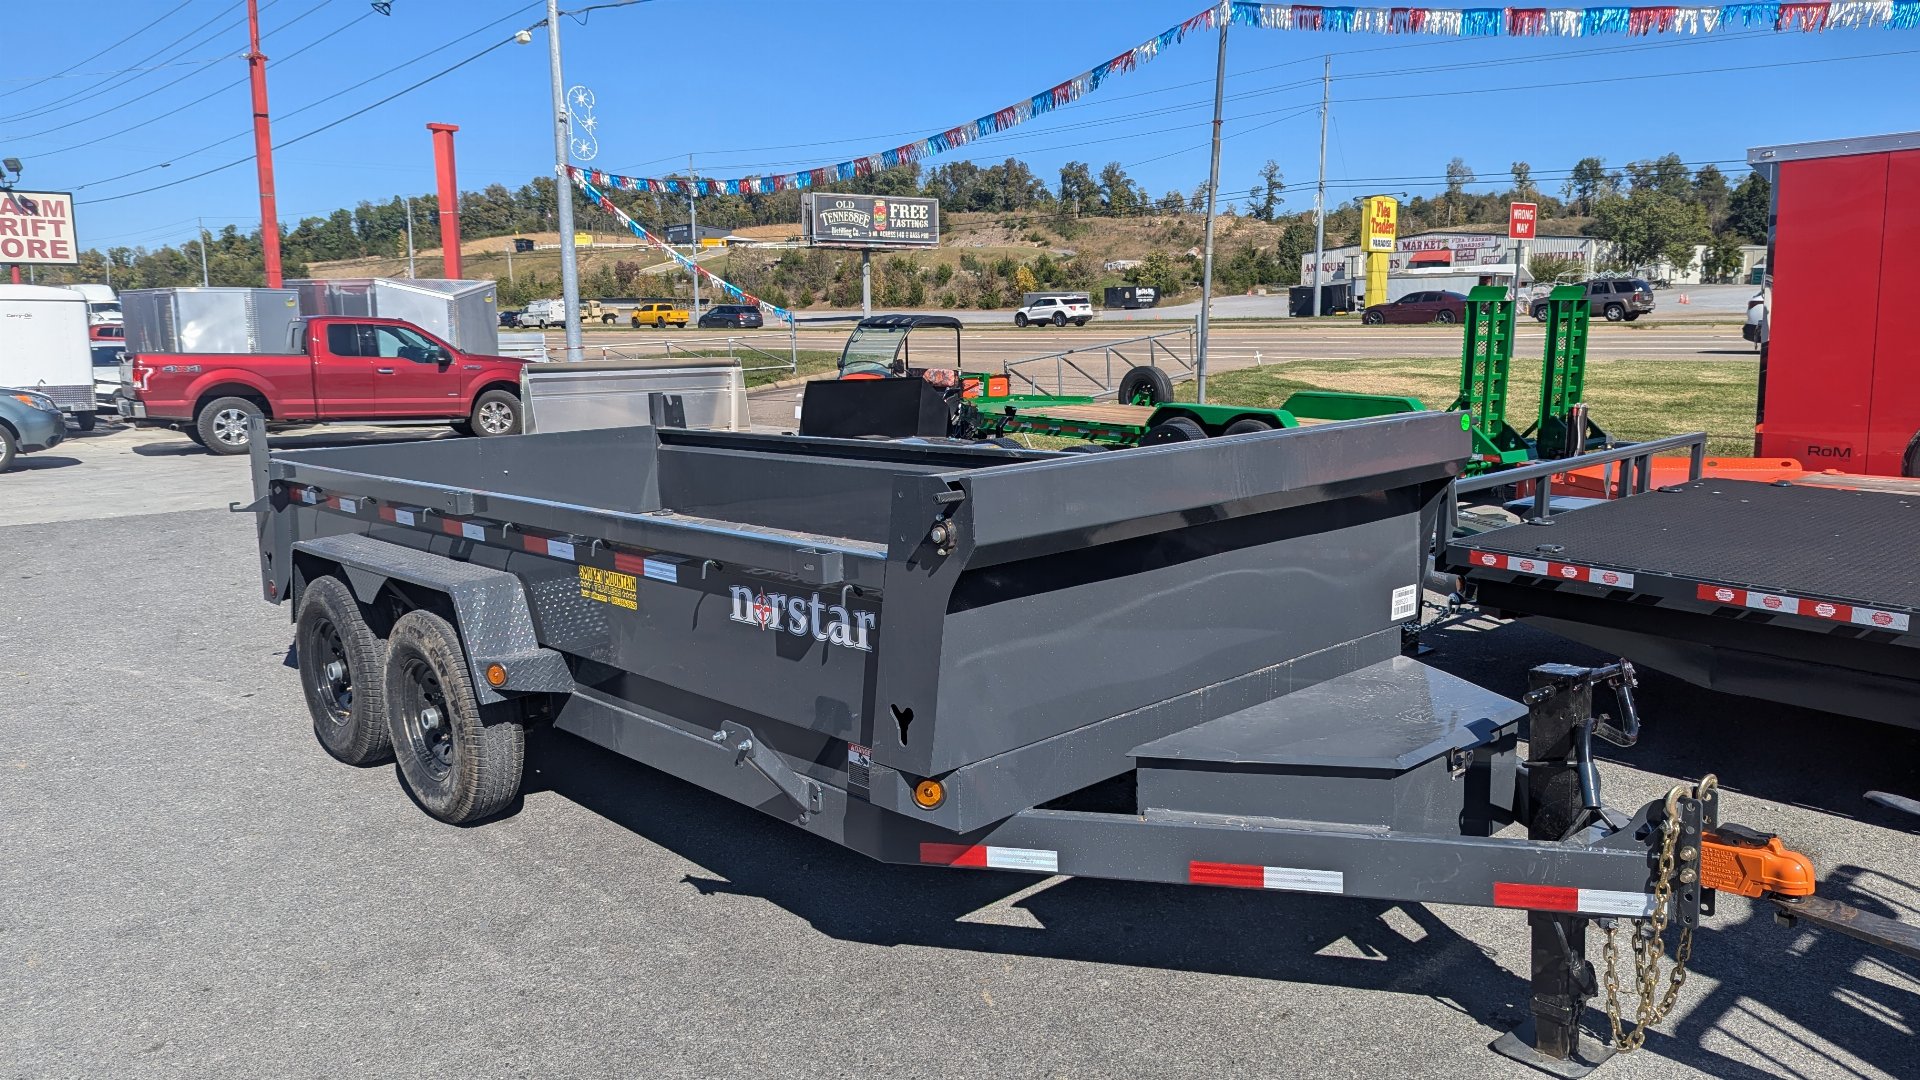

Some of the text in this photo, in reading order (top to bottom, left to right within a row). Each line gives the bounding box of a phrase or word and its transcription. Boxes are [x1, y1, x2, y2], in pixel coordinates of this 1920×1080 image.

[836, 200, 854, 208] OLD
[889, 203, 928, 218] FREE
[1513, 209, 1533, 220] WRONG
[820, 211, 870, 229] TENNESSEE
[890, 219, 928, 228] TASTINGS
[1371, 216, 1395, 234] Traders
[1517, 223, 1529, 233] WAY
[1372, 239, 1391, 247] PARADISE
[1402, 240, 1441, 251] MARKET
[1482, 256, 1500, 265] FOOD
[1304, 261, 1345, 273] ANIQUES
[1807, 445, 1851, 458] RoM
